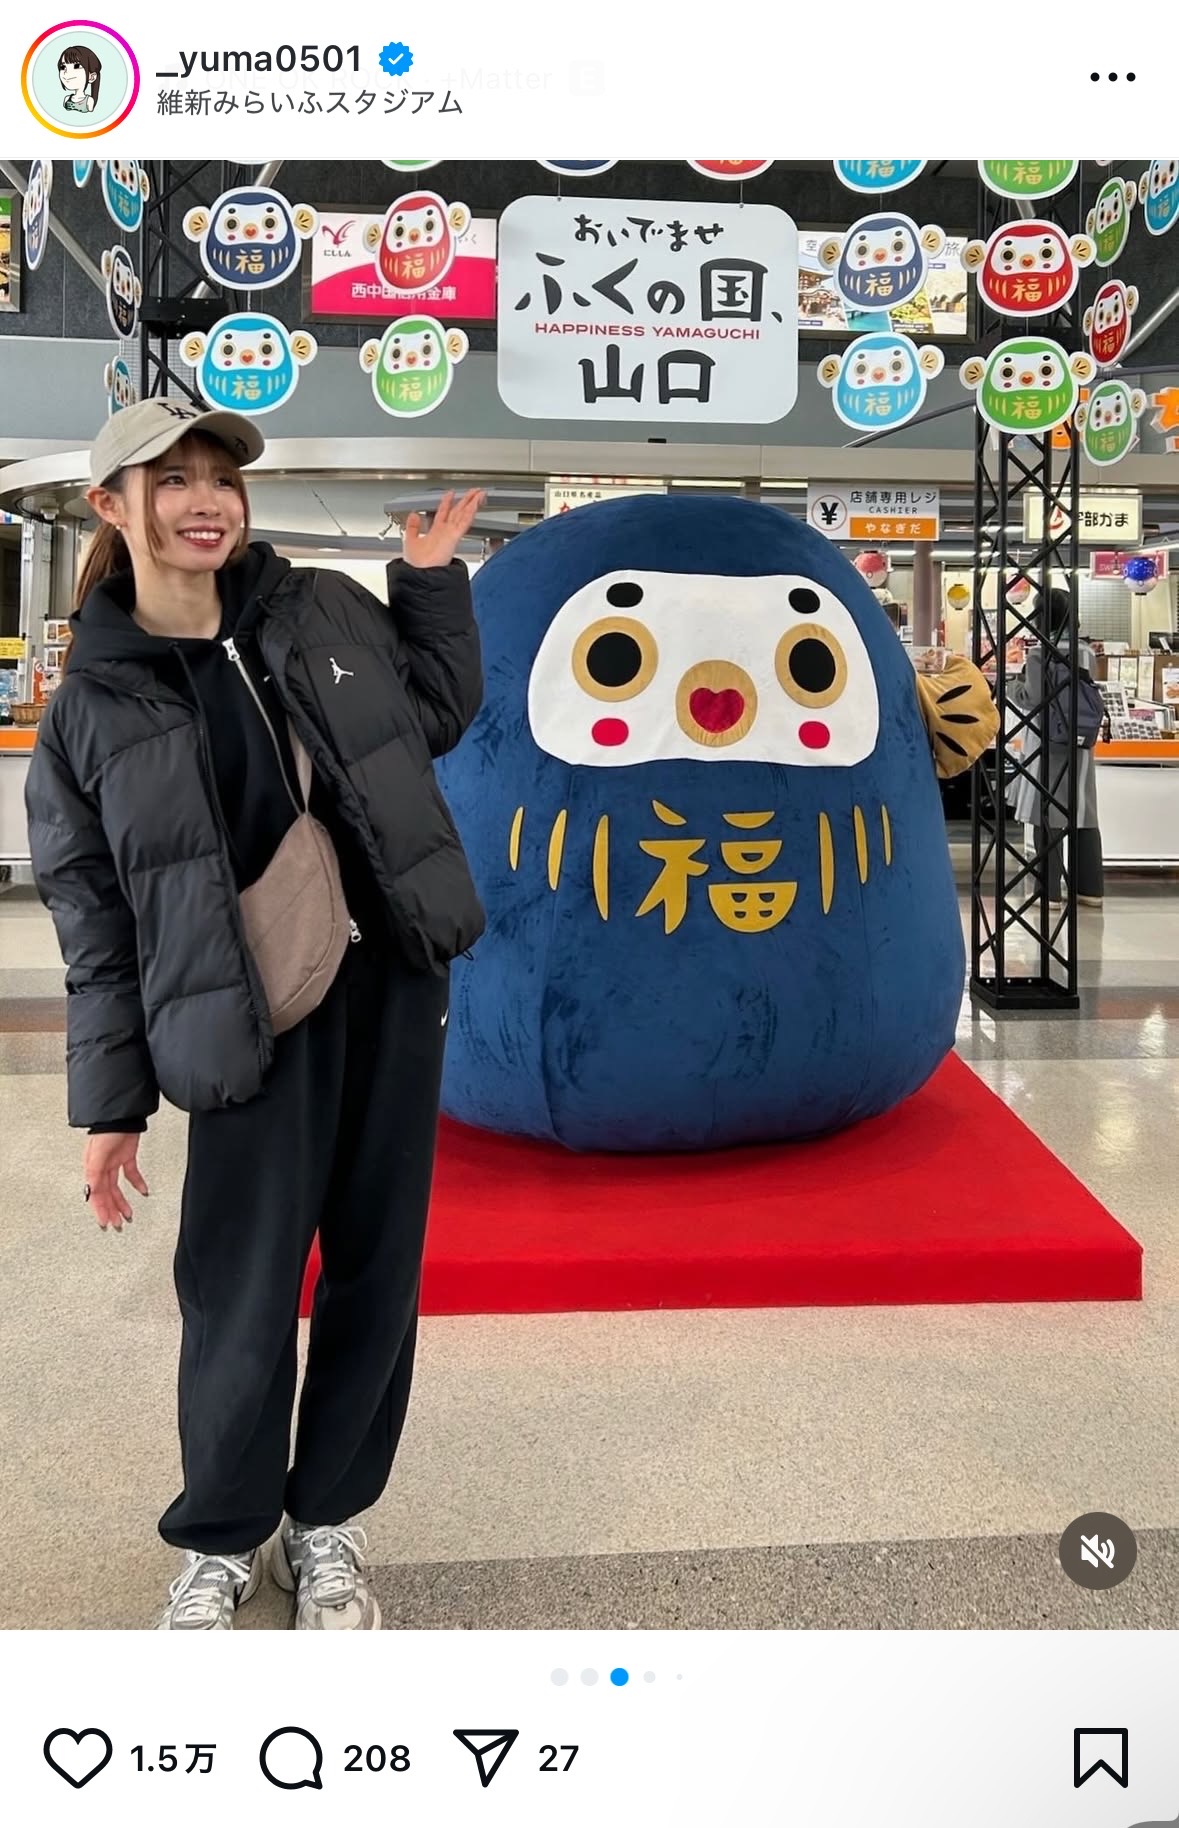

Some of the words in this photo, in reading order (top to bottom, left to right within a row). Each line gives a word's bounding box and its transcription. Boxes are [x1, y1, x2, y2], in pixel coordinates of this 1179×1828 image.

[1012, 161, 1042, 185] 福
[574, 214, 724, 252] おいでませ
[235, 248, 265, 275] 福
[402, 253, 426, 280] 福
[514, 252, 783, 323] ふくの国、
[865, 271, 894, 298] 福
[1011, 278, 1042, 303] 福
[535, 323, 645, 337] HAPPINESS
[652, 326, 759, 341] YAMAGUCHI
[578, 344, 716, 404] 山口
[231, 375, 261, 401] 福
[399, 377, 423, 402] 福
[864, 391, 892, 417] 福
[1011, 395, 1042, 420] 福
[850, 490, 937, 505] 店舗専用レジ
[869, 505, 918, 515] CASHIER
[864, 522, 921, 535] やなぎだ
[635, 800, 798, 935] 福
